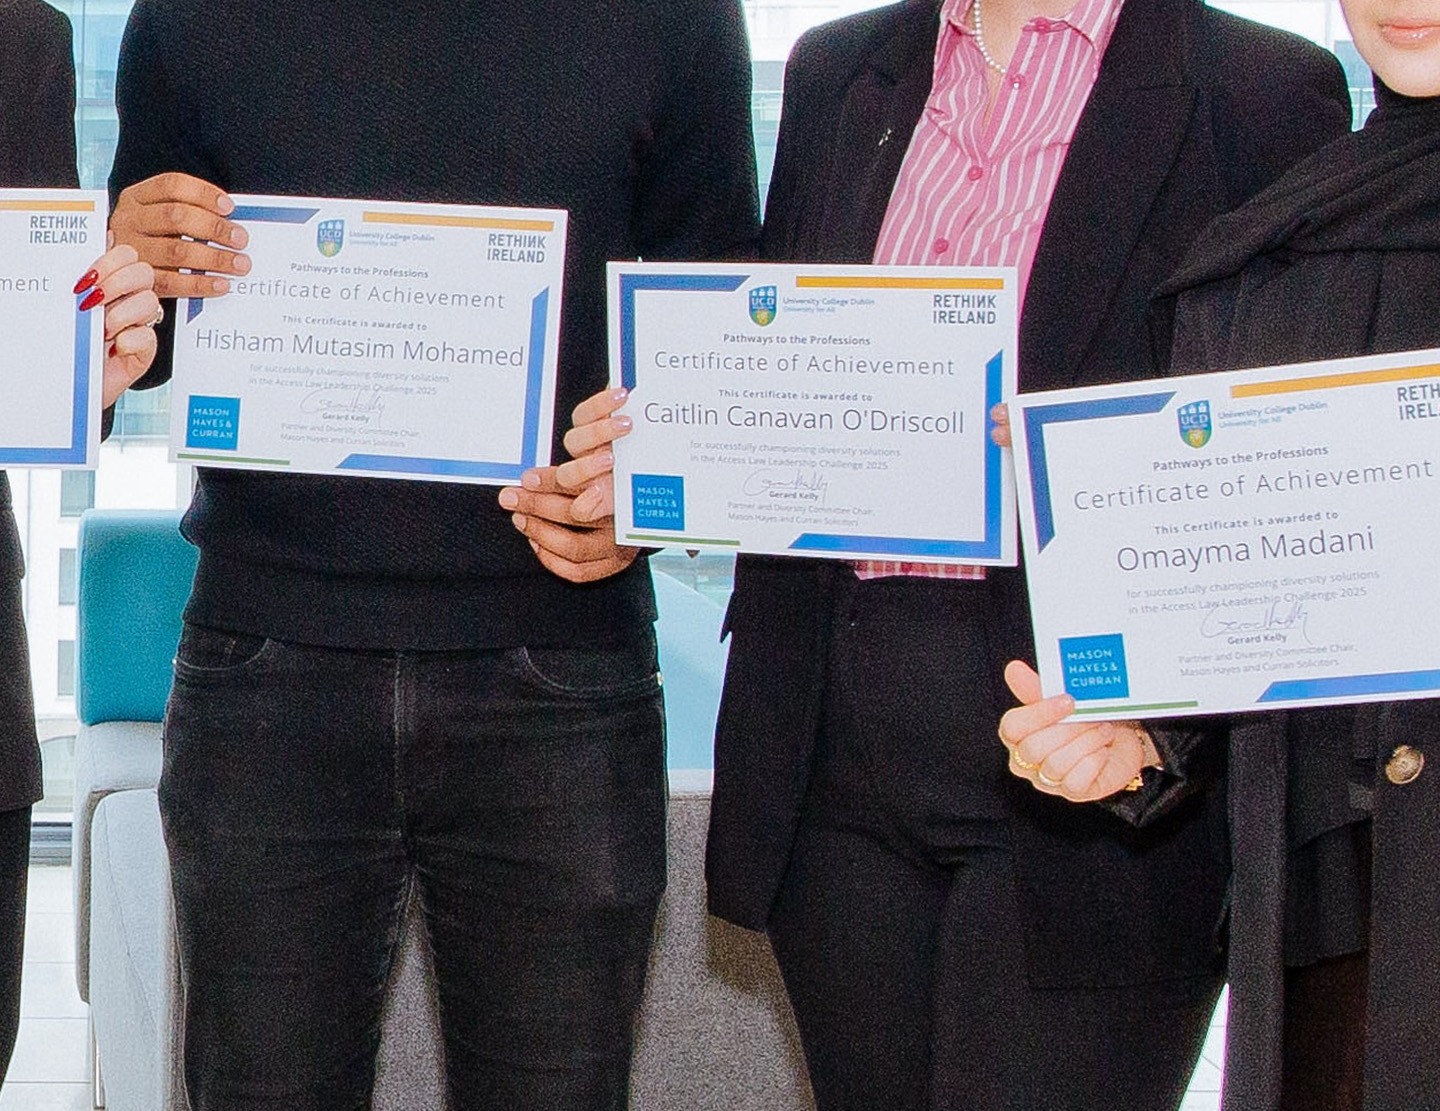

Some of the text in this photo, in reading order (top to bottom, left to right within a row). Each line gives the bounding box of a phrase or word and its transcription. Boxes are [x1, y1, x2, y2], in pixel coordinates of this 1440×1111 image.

[29, 230, 87, 244] IRELAND
[319, 230, 341, 238] UCD
[487, 248, 544, 263] IRELAND
[290, 262, 429, 278] Pathways to the Professions
[339, 283, 361, 300] of
[367, 286, 504, 308] Achievement
[751, 297, 774, 306] UCD
[282, 315, 301, 323] This
[304, 316, 357, 326] Certificate
[360, 319, 368, 327] is
[371, 321, 414, 329] awarded
[933, 310, 996, 324] IRELAND
[723, 333, 870, 346] Pathways to the Professions
[196, 328, 524, 366] Hisham Mutasim Mohamed
[654, 351, 954, 375] Certificate of Achievement
[719, 389, 739, 397] This
[742, 390, 798, 399] Certificate
[801, 391, 809, 399] is
[813, 392, 858, 400] awarded
[193, 408, 229, 416] MASON
[321, 413, 369, 424] Gerard Kelly
[644, 402, 963, 433] Caitlin Canavan O'Driscoll
[1180, 414, 1208, 426] UCD
[192, 429, 232, 439] CURRAN
[1152, 446, 1328, 471] Pathways to the Professions
[637, 487, 673, 495] MASON
[1074, 460, 1433, 510] Certificate of Achievement
[768, 489, 818, 500] Gerard Kelly
[638, 509, 679, 518] CURRAN
[1154, 511, 1338, 534] This Certificate is awarded to
[1117, 525, 1373, 573] Omayma Madani
[1226, 633, 1287, 645] Gerard Kelly
[1067, 649, 1112, 659] MASON
[1071, 675, 1121, 686] CURRAN
